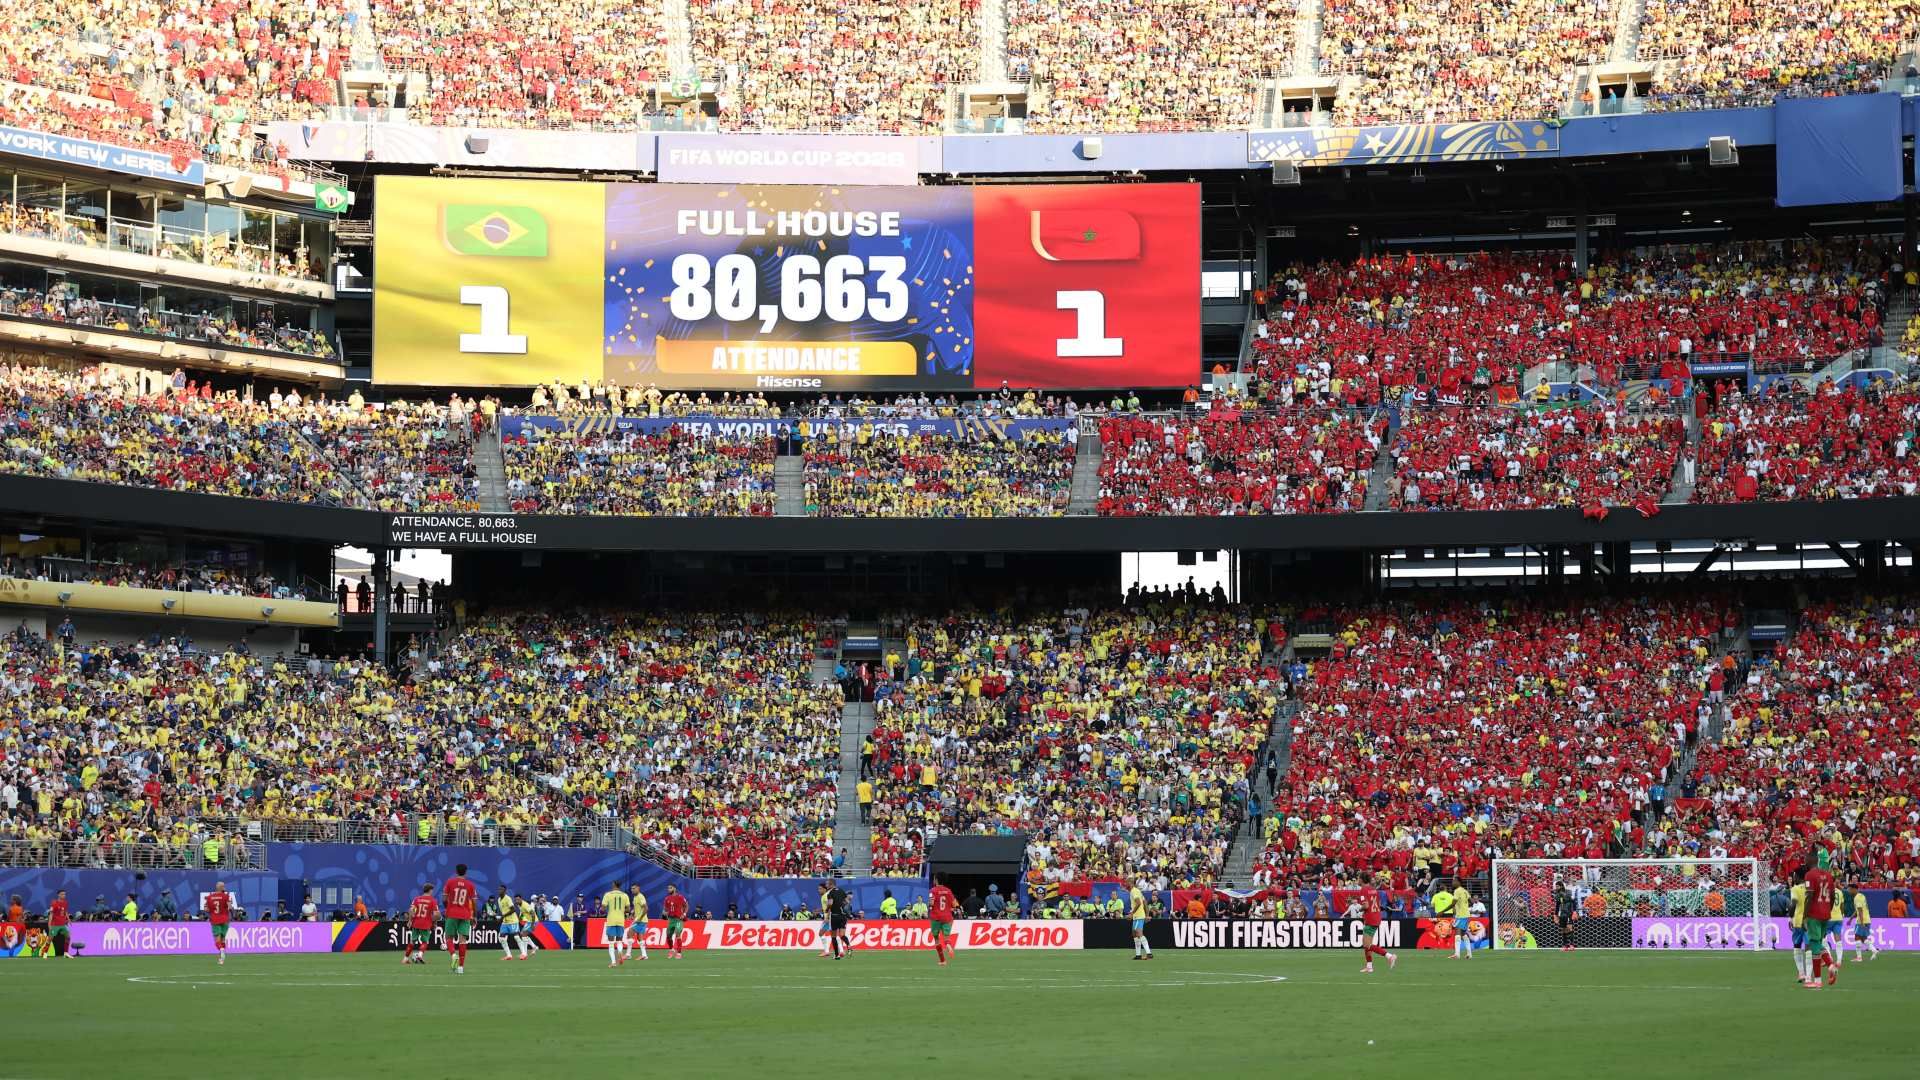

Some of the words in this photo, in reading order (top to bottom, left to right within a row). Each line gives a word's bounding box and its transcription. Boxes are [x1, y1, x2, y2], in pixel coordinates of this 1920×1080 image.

[61, 142, 110, 163] NEW
[669, 149, 712, 165] FIFA
[716, 150, 787, 166] WORLD
[791, 151, 832, 166] CUP
[677, 209, 766, 236] FULL
[777, 210, 900, 237] HOUSE
[670, 253, 909, 334] 80,663
[459, 285, 527, 353] 1
[1056, 290, 1123, 357] 1
[711, 346, 862, 371] ATTENDANCE
[756, 375, 822, 388] Hisense
[392, 516, 475, 529] ATTENDANCE,
[478, 517, 518, 529] 80,663.
[392, 531, 412, 542] WE
[415, 532, 446, 543] HAVE
[449, 533, 457, 543] A
[460, 533, 488, 543] FULL
[491, 533, 537, 544] HOUSE!
[452, 887, 467, 906] 18
[614, 896, 622, 911] 11
[939, 896, 946, 911] 6
[1818, 882, 1831, 903] 14
[213, 900, 220, 914] 3
[416, 903, 429, 918] 15
[122, 927, 190, 950] kraken
[241, 926, 303, 949] kraken
[720, 923, 816, 948] Betano
[844, 923, 937, 947] Betano
[968, 922, 1069, 947] Betano
[1172, 920, 1228, 948] VISIT
[1232, 920, 1400, 948] FIFASTORE.CM
